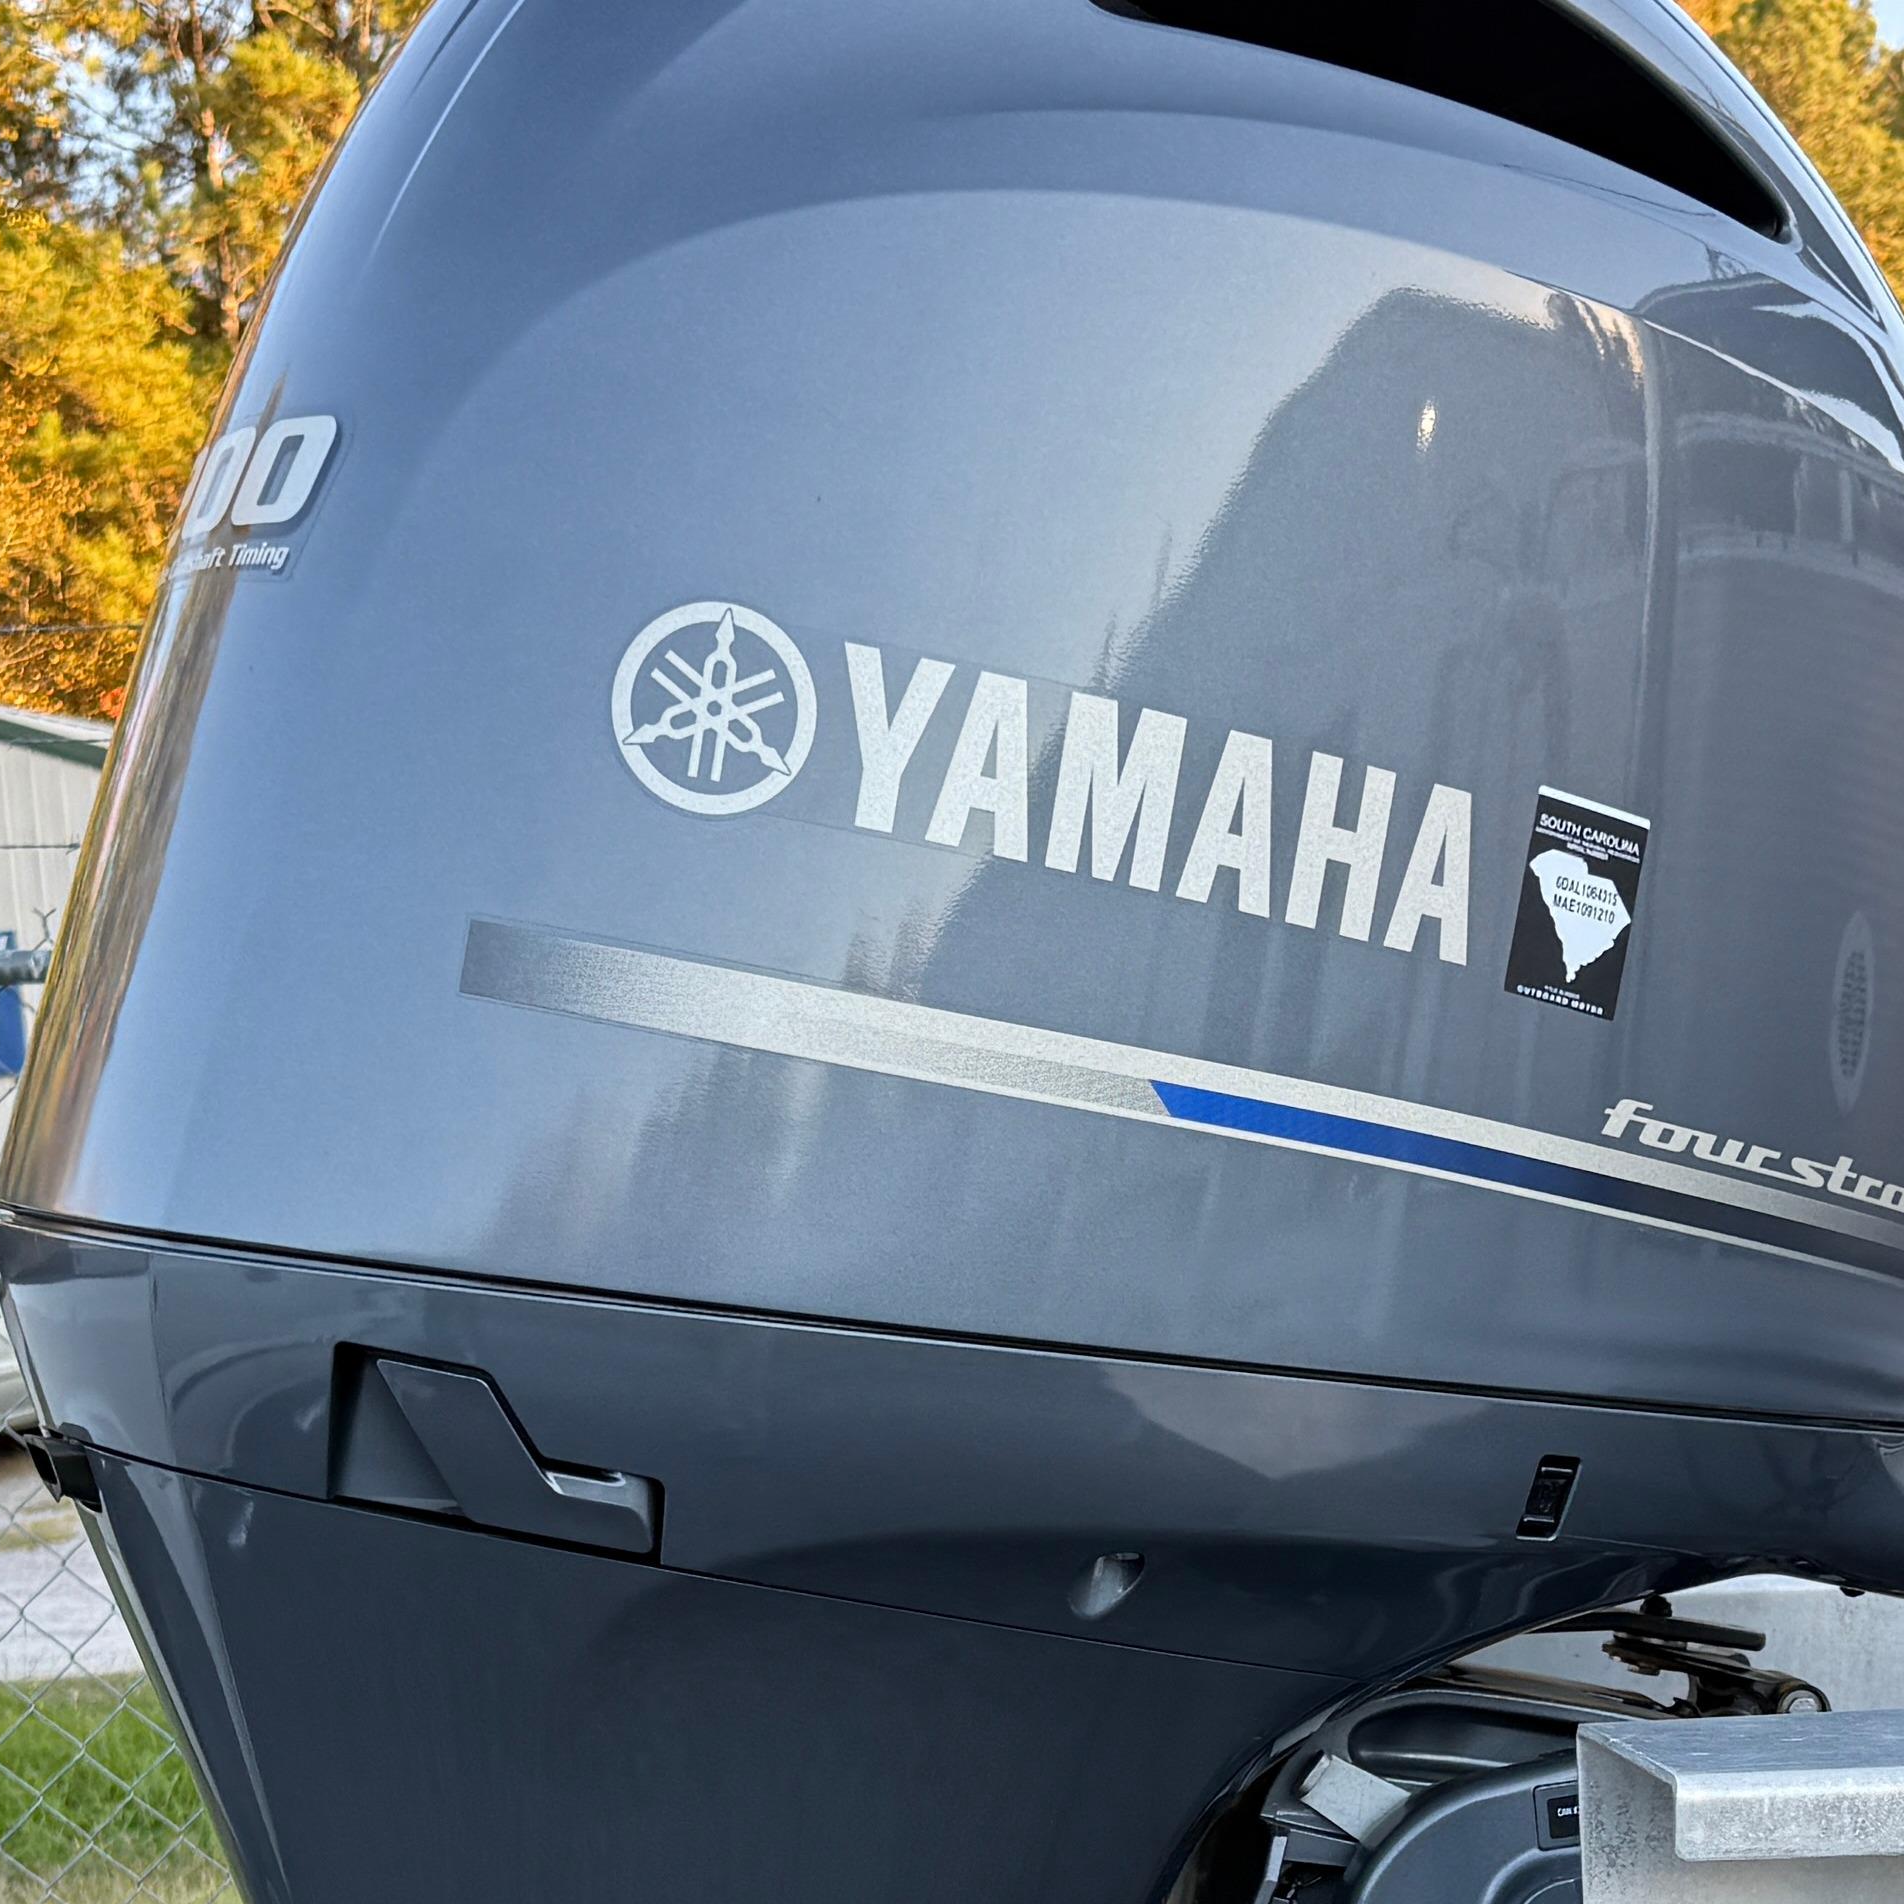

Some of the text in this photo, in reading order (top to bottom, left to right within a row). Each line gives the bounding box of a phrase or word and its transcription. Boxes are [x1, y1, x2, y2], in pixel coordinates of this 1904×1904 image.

[228, 541, 290, 570] Timing
[844, 641, 1473, 967] YAMAHA
[1539, 813, 1582, 837] SOUTH
[1582, 827, 1640, 857] CAROLINA
